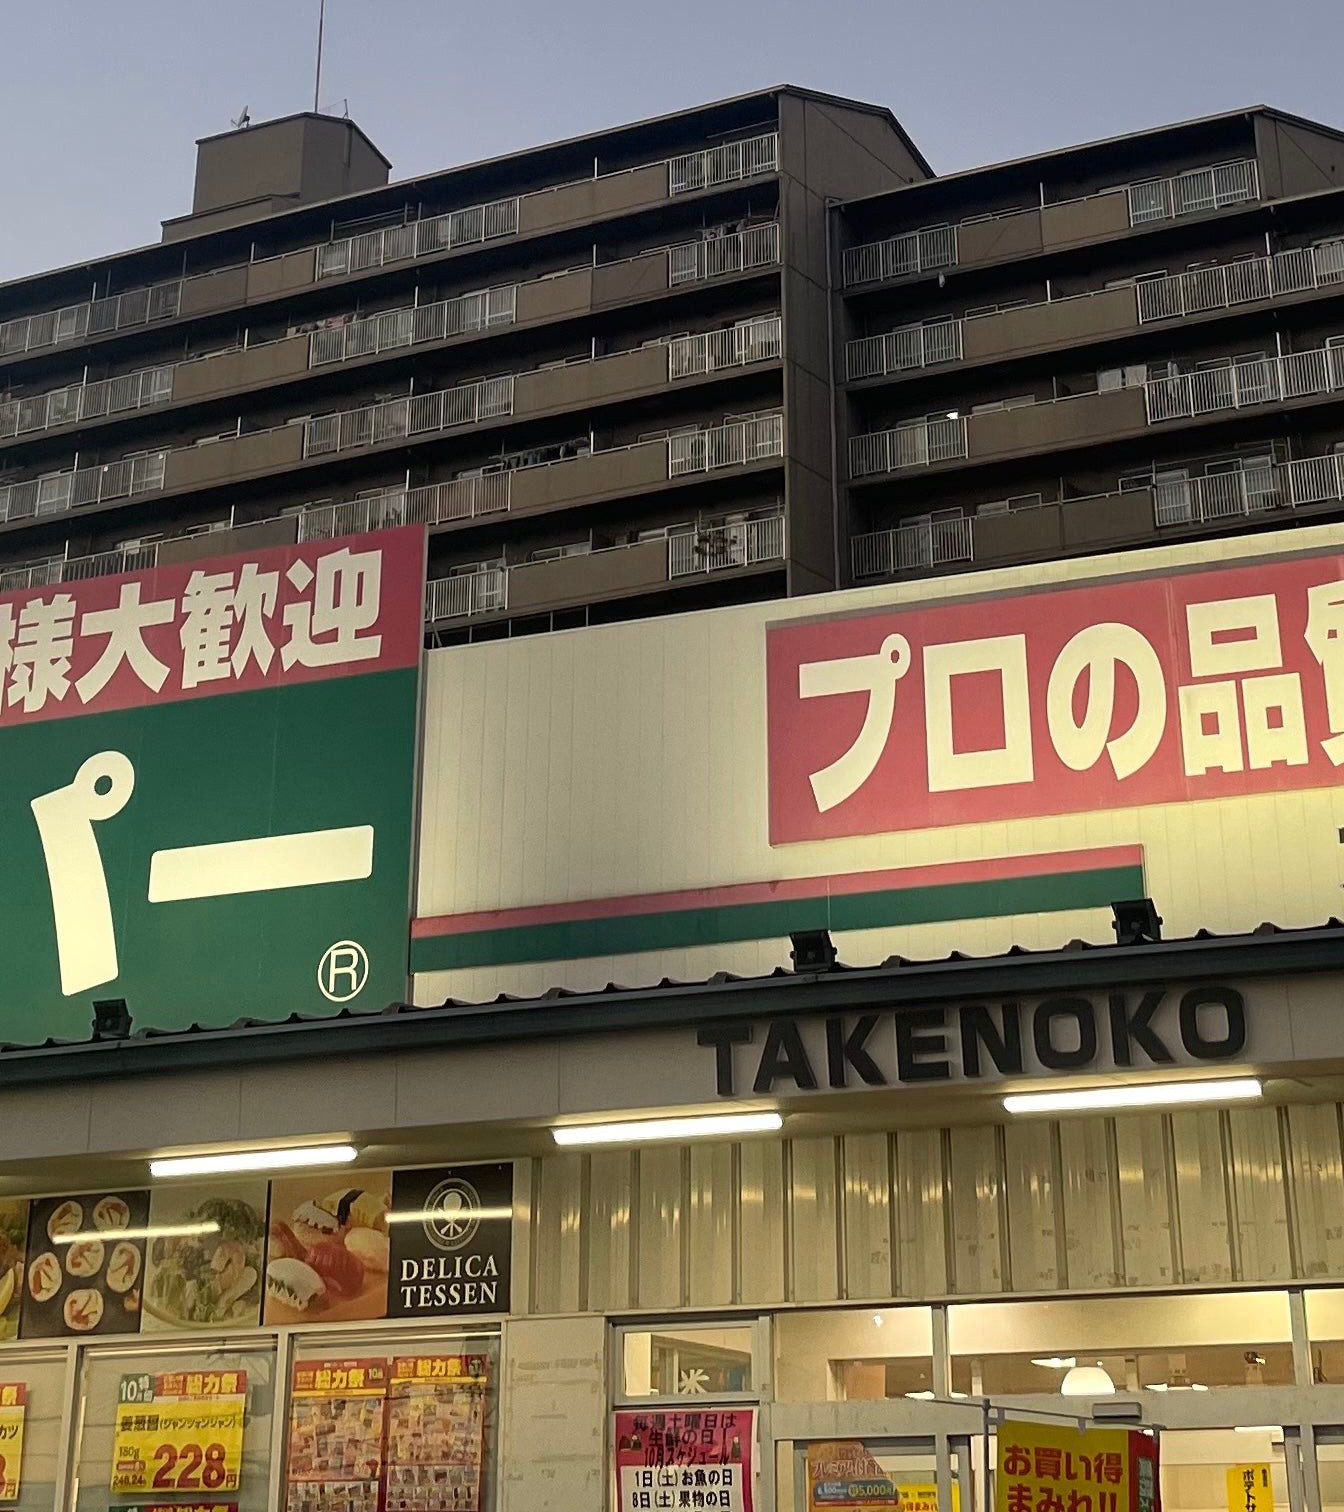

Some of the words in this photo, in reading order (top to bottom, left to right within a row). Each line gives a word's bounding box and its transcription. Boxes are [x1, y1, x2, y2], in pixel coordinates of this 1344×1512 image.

[696, 986, 1247, 1096] TAKENOKO
[400, 1254, 499, 1282] DELICA
[400, 1281, 498, 1309] TESSEN
[1003, 1444, 1124, 1485] お買い得
